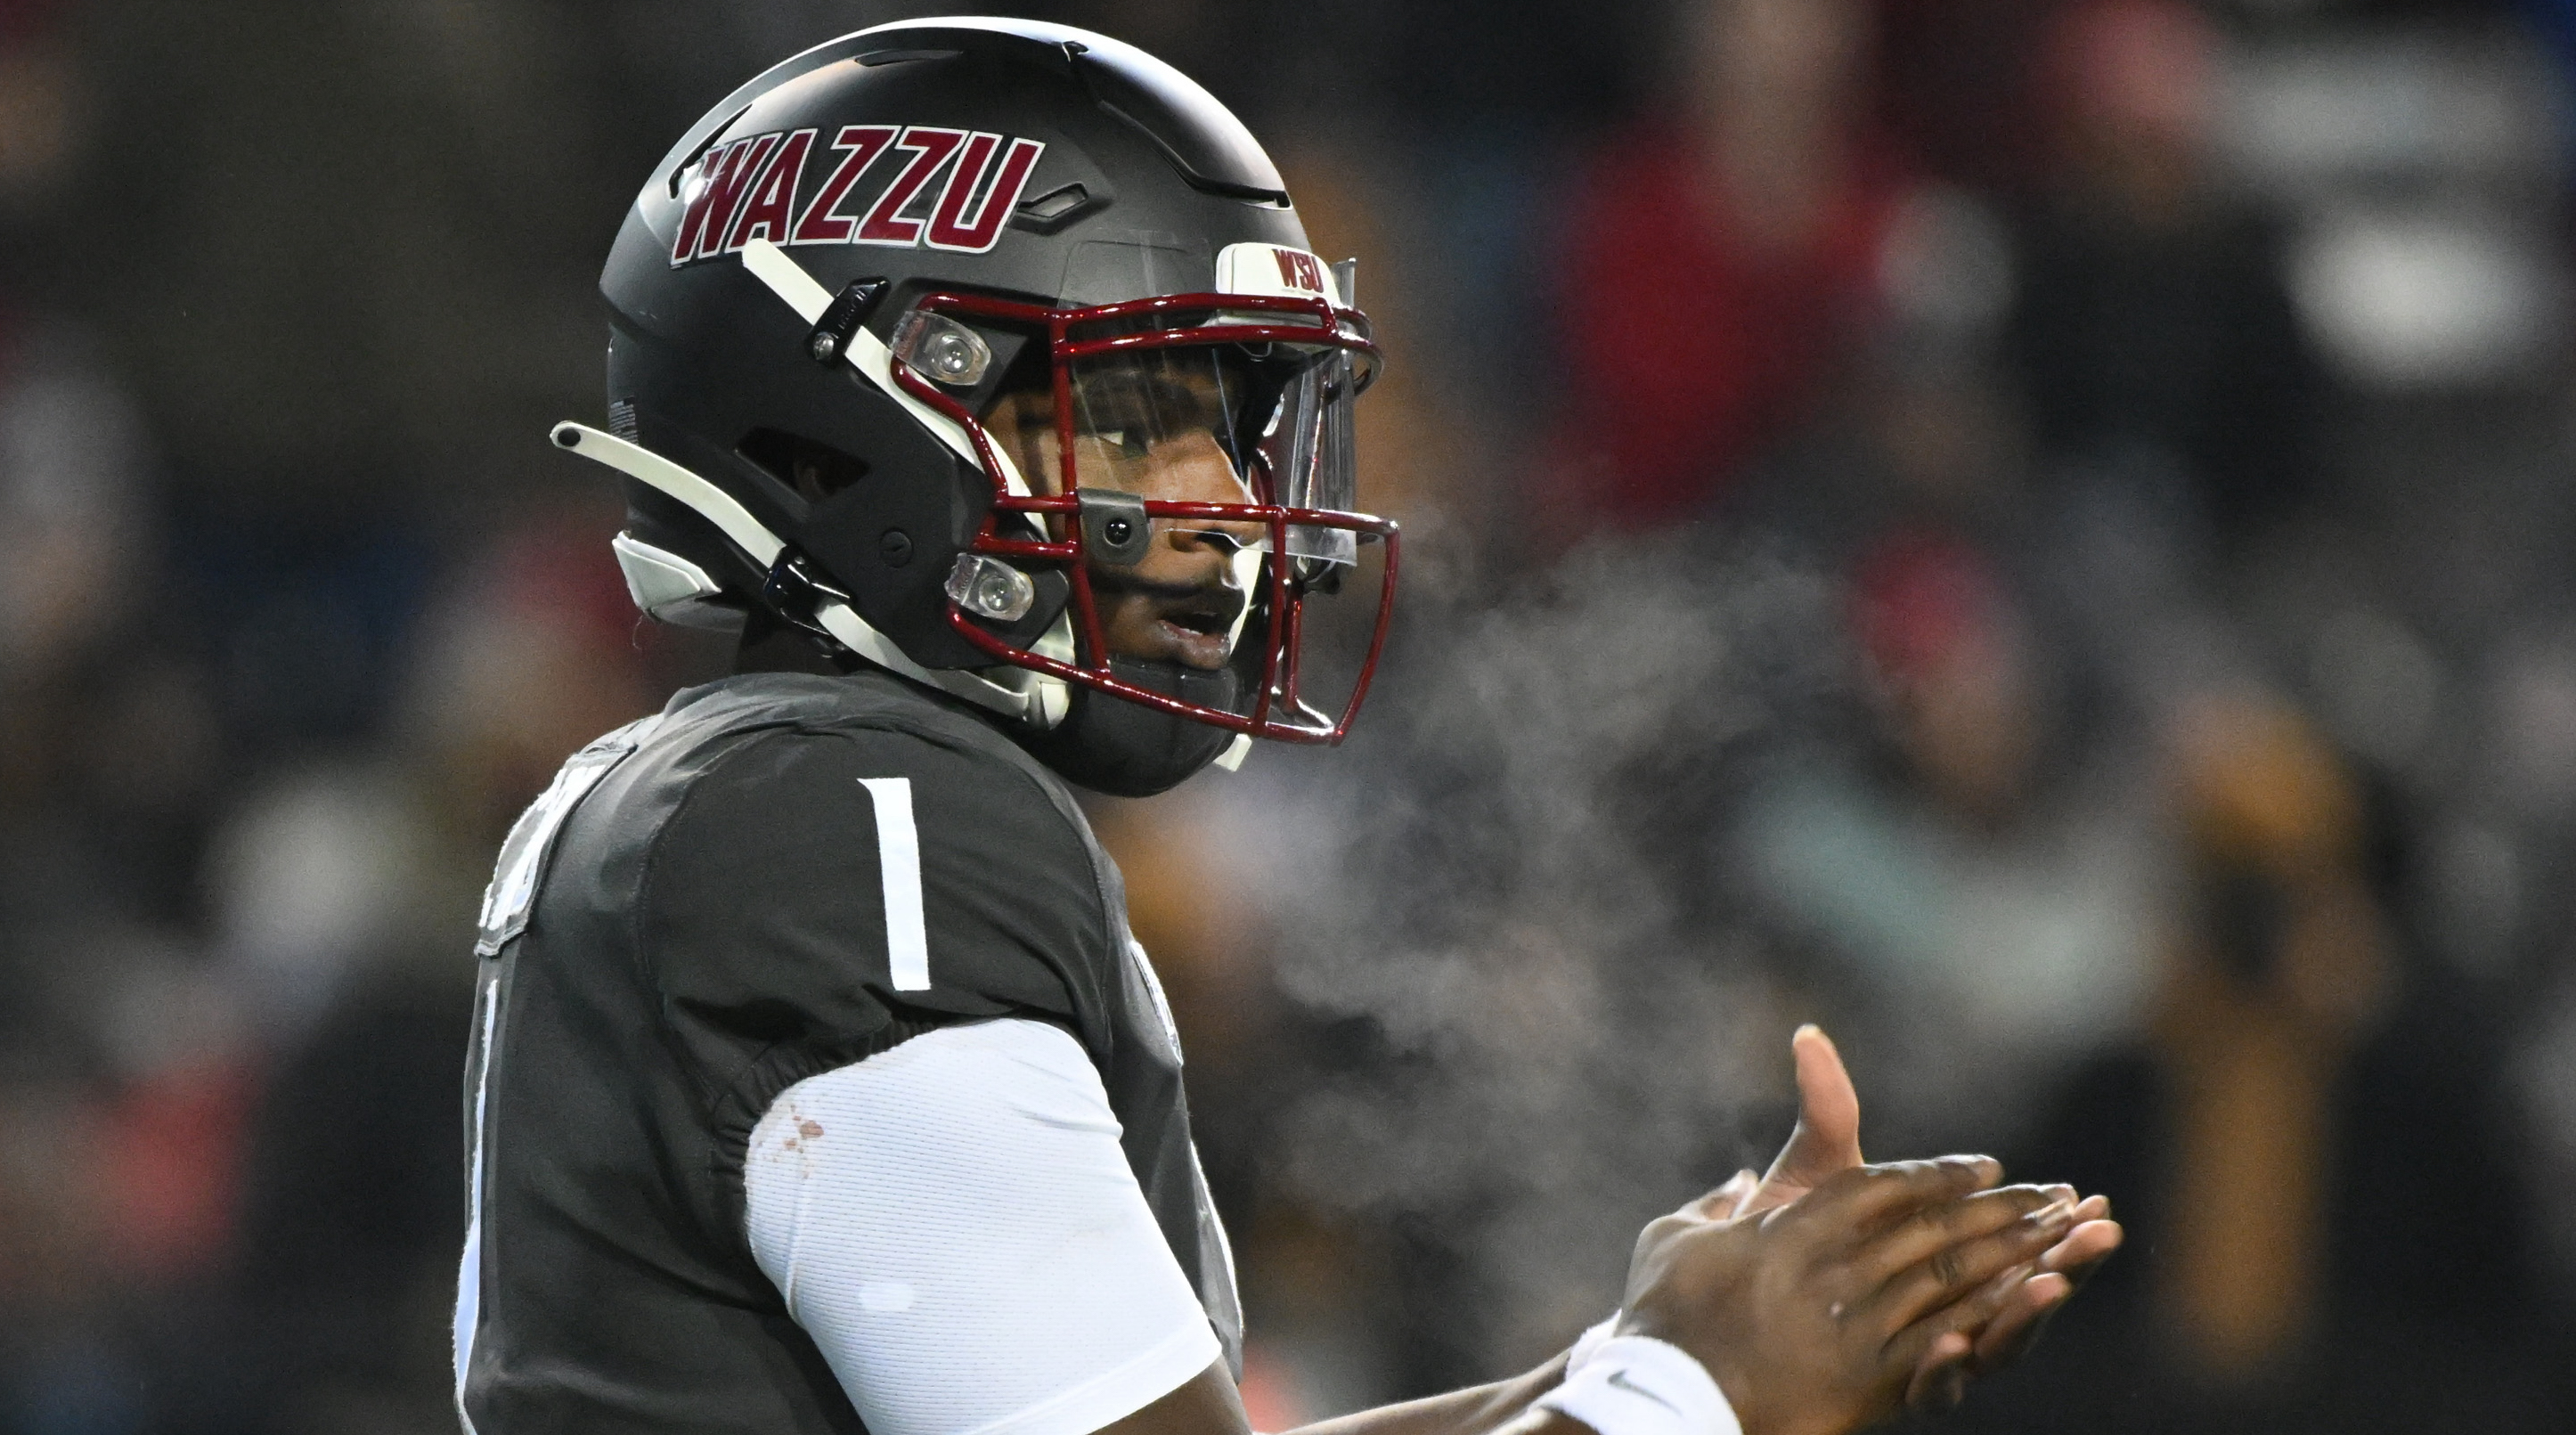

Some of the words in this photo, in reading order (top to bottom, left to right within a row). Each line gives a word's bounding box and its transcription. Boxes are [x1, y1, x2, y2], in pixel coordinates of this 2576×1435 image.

[671, 125, 1046, 265] WAZZU
[1272, 249, 1324, 293] WSU
[856, 778, 931, 991] 1
